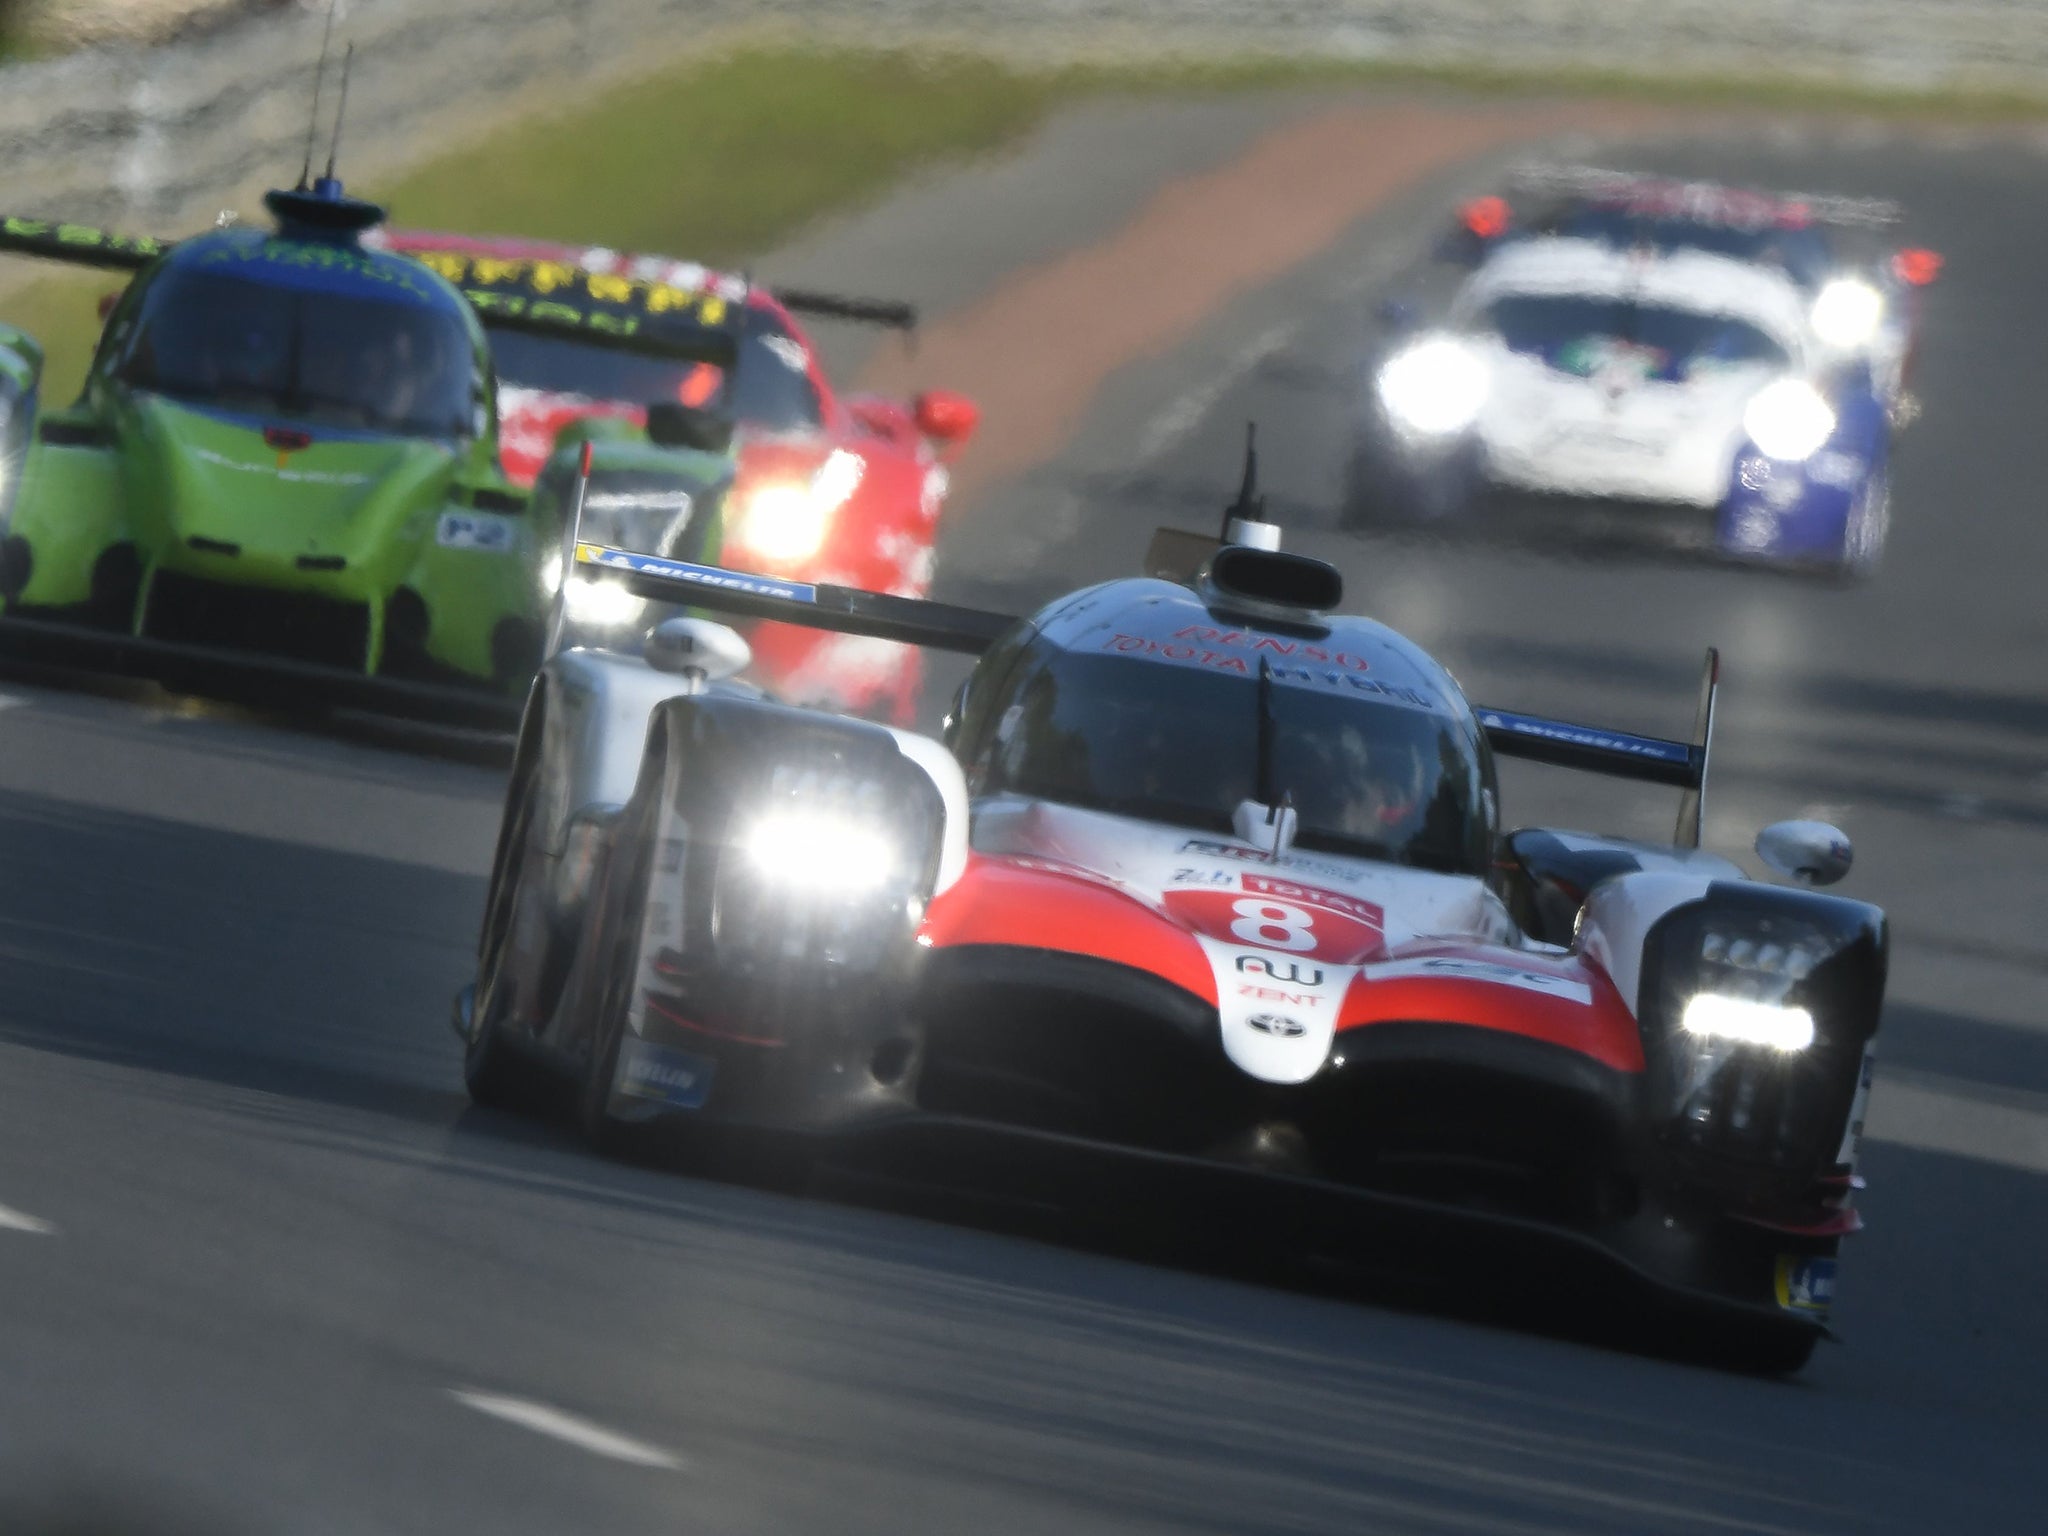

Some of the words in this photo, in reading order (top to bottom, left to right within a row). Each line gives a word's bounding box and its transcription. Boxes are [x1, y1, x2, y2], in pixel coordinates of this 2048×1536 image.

[639, 562, 795, 600] MICHELIN
[1103, 634, 1249, 673] TOYOTA
[1174, 625, 1369, 672] DENSO
[1513, 722, 1667, 758] MICHELIN
[1248, 876, 1379, 921] TOTAL
[1231, 898, 1318, 951] 8
[1236, 984, 1326, 1007] ZENT
